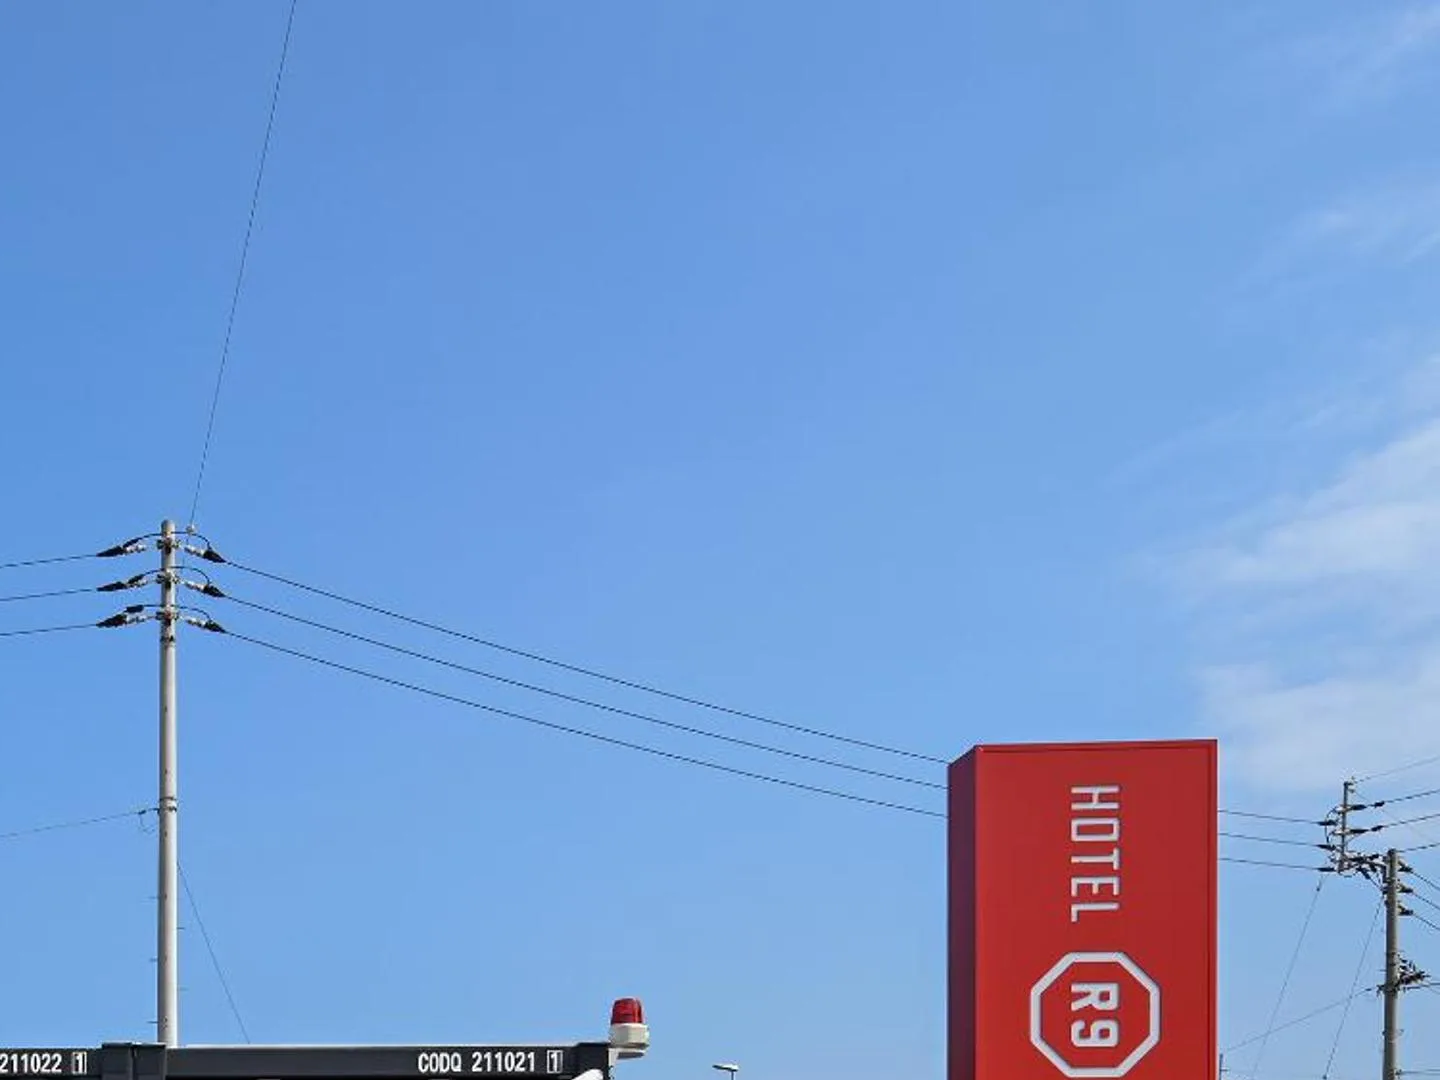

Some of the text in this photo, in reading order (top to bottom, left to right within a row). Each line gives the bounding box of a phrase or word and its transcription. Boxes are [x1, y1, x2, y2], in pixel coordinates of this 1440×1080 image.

[1070, 784, 1121, 923] HOTEL
[1070, 982, 1120, 1048] R9
[418, 1052, 461, 1073] CODQ
[471, 1051, 535, 1073] 211021
